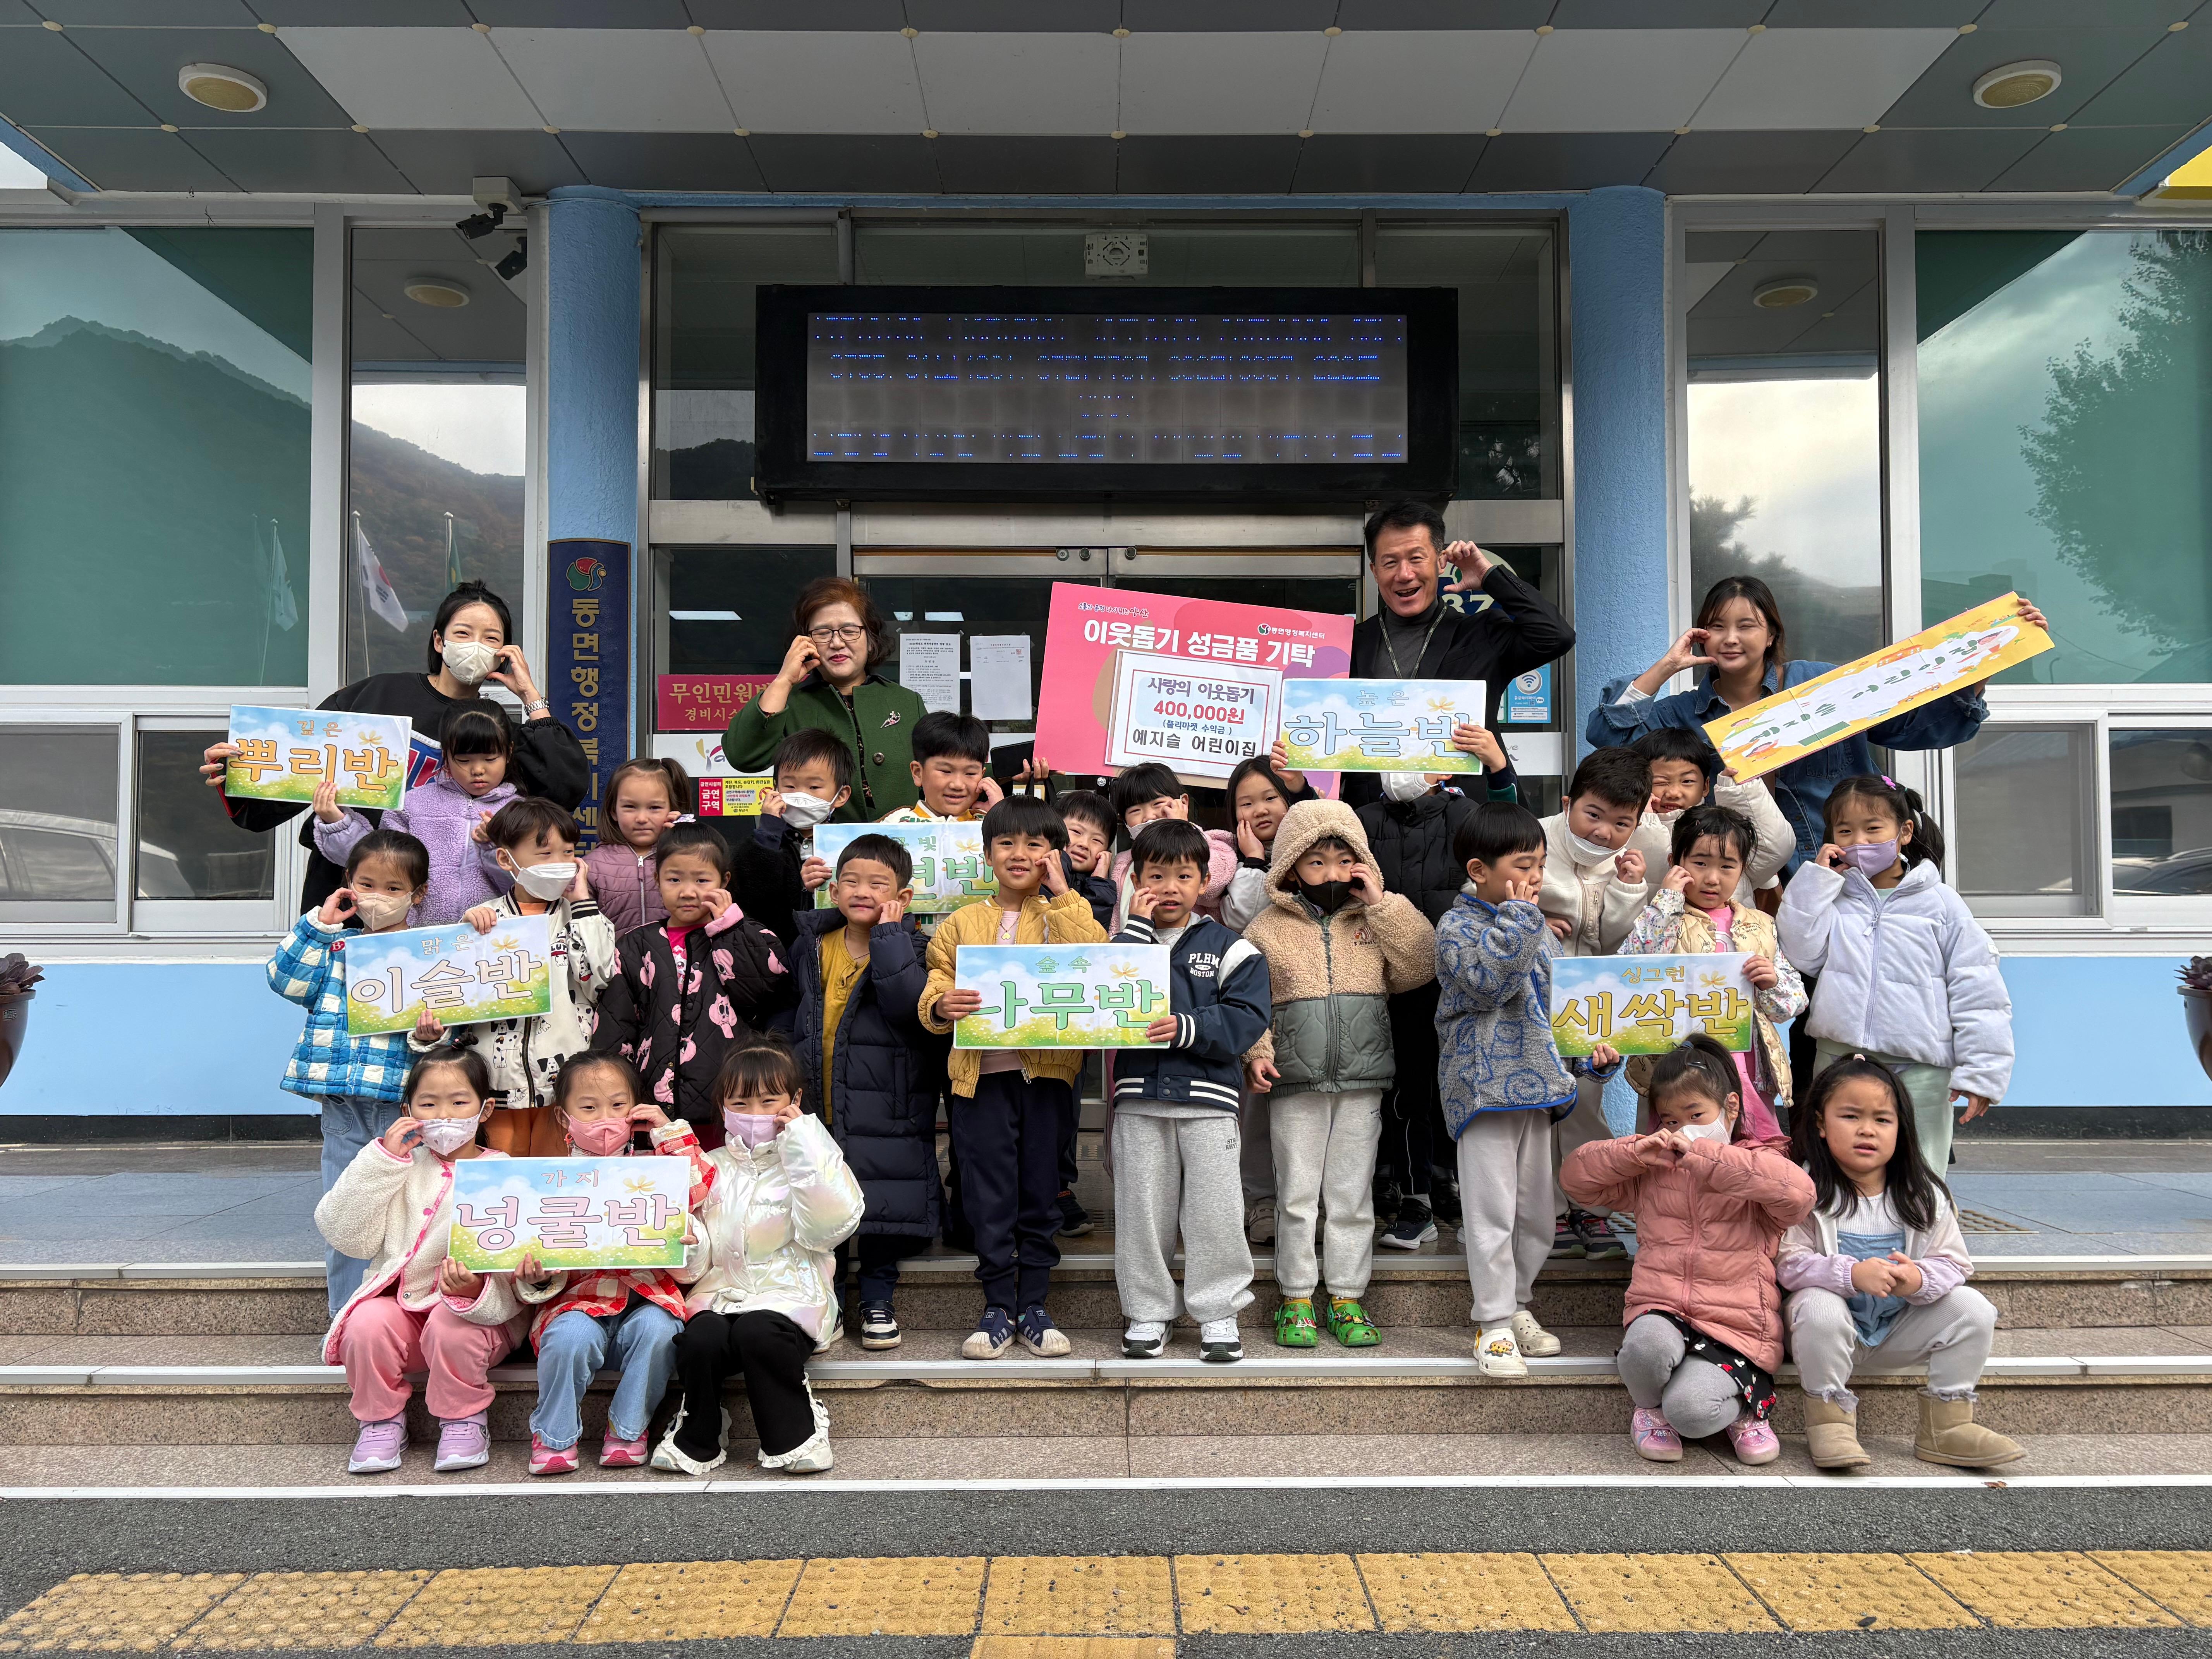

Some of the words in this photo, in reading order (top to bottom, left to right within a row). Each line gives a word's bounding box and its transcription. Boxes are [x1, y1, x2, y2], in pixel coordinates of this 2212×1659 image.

[1130, 607, 1149, 618] 양산
[1272, 627, 1325, 639] 동면행정복지센터
[1084, 620, 1179, 653] 이웃돕기
[1187, 632, 1259, 661] 성금품
[1265, 641, 1315, 668] 기탁
[1147, 678, 1191, 697] 사랑의
[1198, 683, 1254, 704] 이웃돕기
[1357, 690, 1410, 706] 높은
[1153, 700, 1244, 724] 400,000원
[297, 720, 342, 737] 깊은
[1163, 720, 1198, 731] (플리마켓
[1285, 712, 1470, 757] 하늘반
[1133, 729, 1181, 749] 예지슬
[1192, 736, 1256, 757] 어린이집
[229, 738, 398, 791] 뿌리반
[701, 789, 719, 799] 금연
[701, 801, 719, 811] 구역
[421, 934, 474, 955] 맑은
[1035, 956, 1092, 974] 숲속
[1188, 953, 1220, 968] PLHM
[351, 950, 542, 1013] 이슬반
[1190, 967, 1214, 977] BOSTON
[1622, 965, 1685, 984] 싱그런
[969, 979, 1164, 1030] 나무반
[1553, 988, 1748, 1037] 새싹반
[541, 1169, 599, 1187] 가지
[456, 1194, 680, 1250] 넝쿨반
